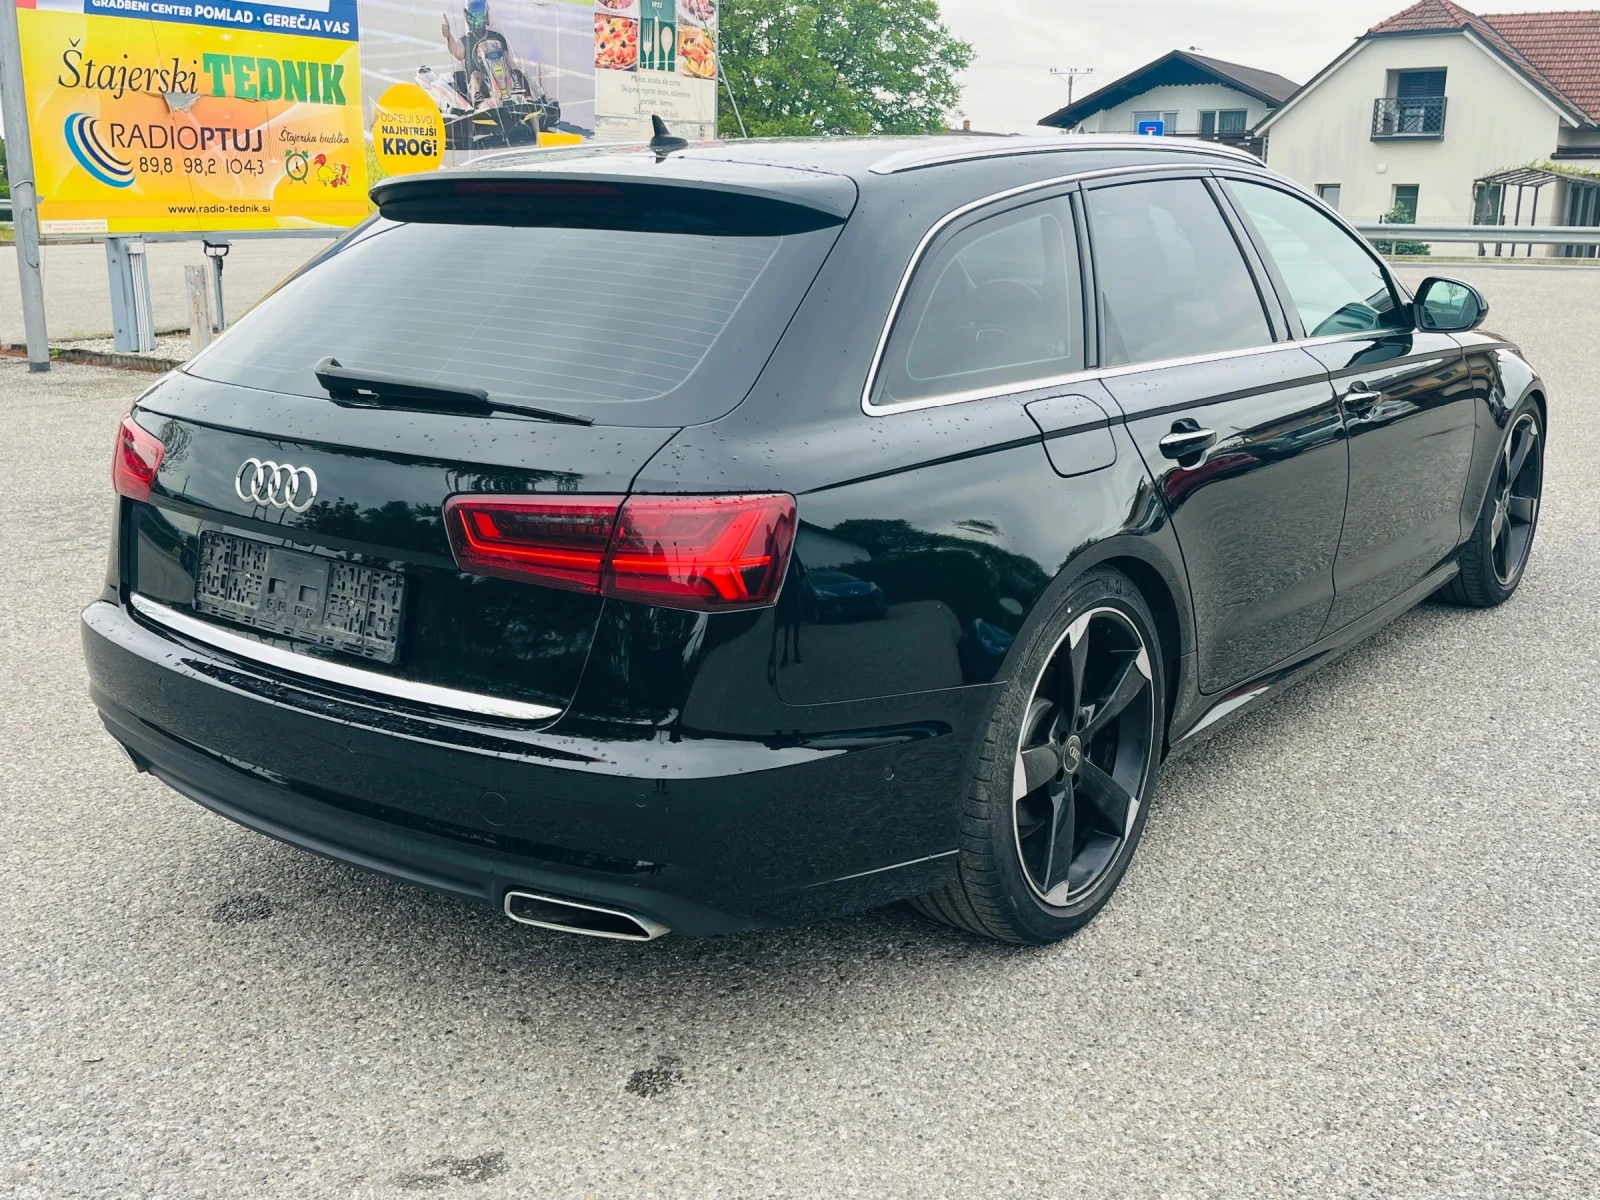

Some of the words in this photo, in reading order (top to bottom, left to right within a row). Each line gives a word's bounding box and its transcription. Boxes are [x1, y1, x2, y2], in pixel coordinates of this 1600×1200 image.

[91, 0, 150, 12] GRADBENI
[151, 3, 193, 17] CENTER
[194, 4, 254, 23] POMLAD
[263, 13, 322, 31] GEREČJA
[324, 20, 350, 34] VAS
[58, 37, 199, 99] Štajerski
[202, 52, 347, 106] TEDNIK
[381, 113, 414, 124] ODPELJI
[415, 114, 437, 124] SVOJ
[381, 125, 437, 137] NAJHITREJŠI
[382, 137, 438, 157] KROG!
[139, 156, 173, 176] 89,8
[183, 157, 217, 177] 98,2
[226, 158, 264, 177] 104,3
[168, 204, 271, 214] www.radio-tednik.si
